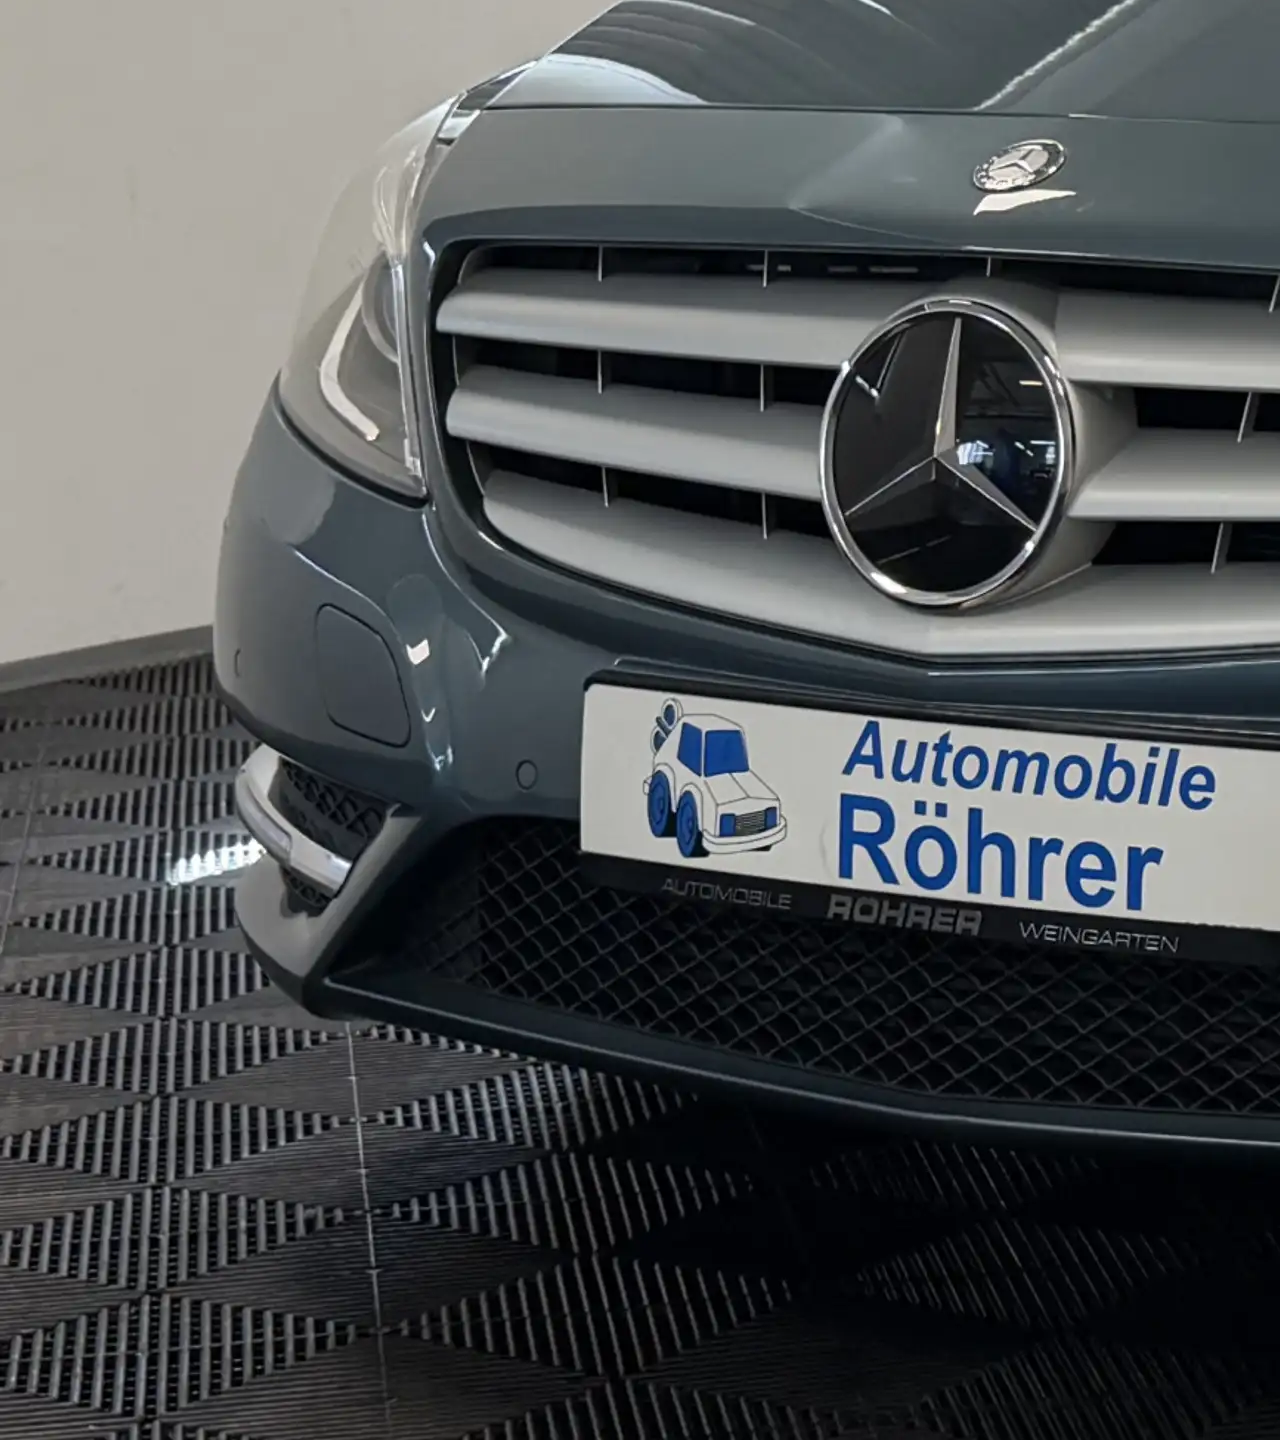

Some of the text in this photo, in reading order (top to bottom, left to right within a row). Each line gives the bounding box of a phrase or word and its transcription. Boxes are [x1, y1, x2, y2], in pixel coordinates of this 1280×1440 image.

[841, 720, 1217, 811] Automobile
[838, 793, 1164, 912] Röhrer
[661, 877, 793, 910] AUTOMOBILE
[1018, 921, 1181, 954] WEINGARTEN
